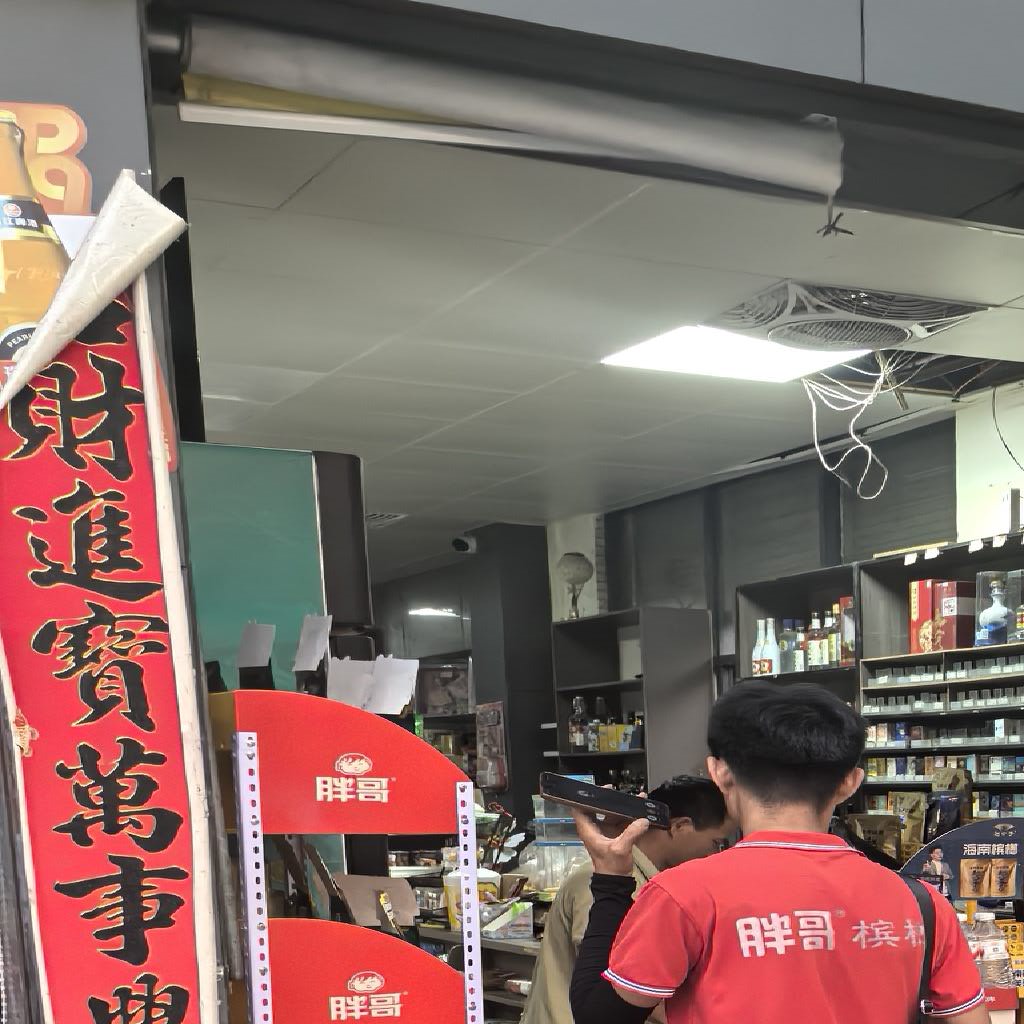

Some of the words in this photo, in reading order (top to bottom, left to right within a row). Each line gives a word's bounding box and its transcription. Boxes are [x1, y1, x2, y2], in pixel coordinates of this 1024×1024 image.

[315, 776, 390, 804] 胖哥
[735, 909, 836, 958] 胖哥
[329, 991, 402, 1021] 胖哥
